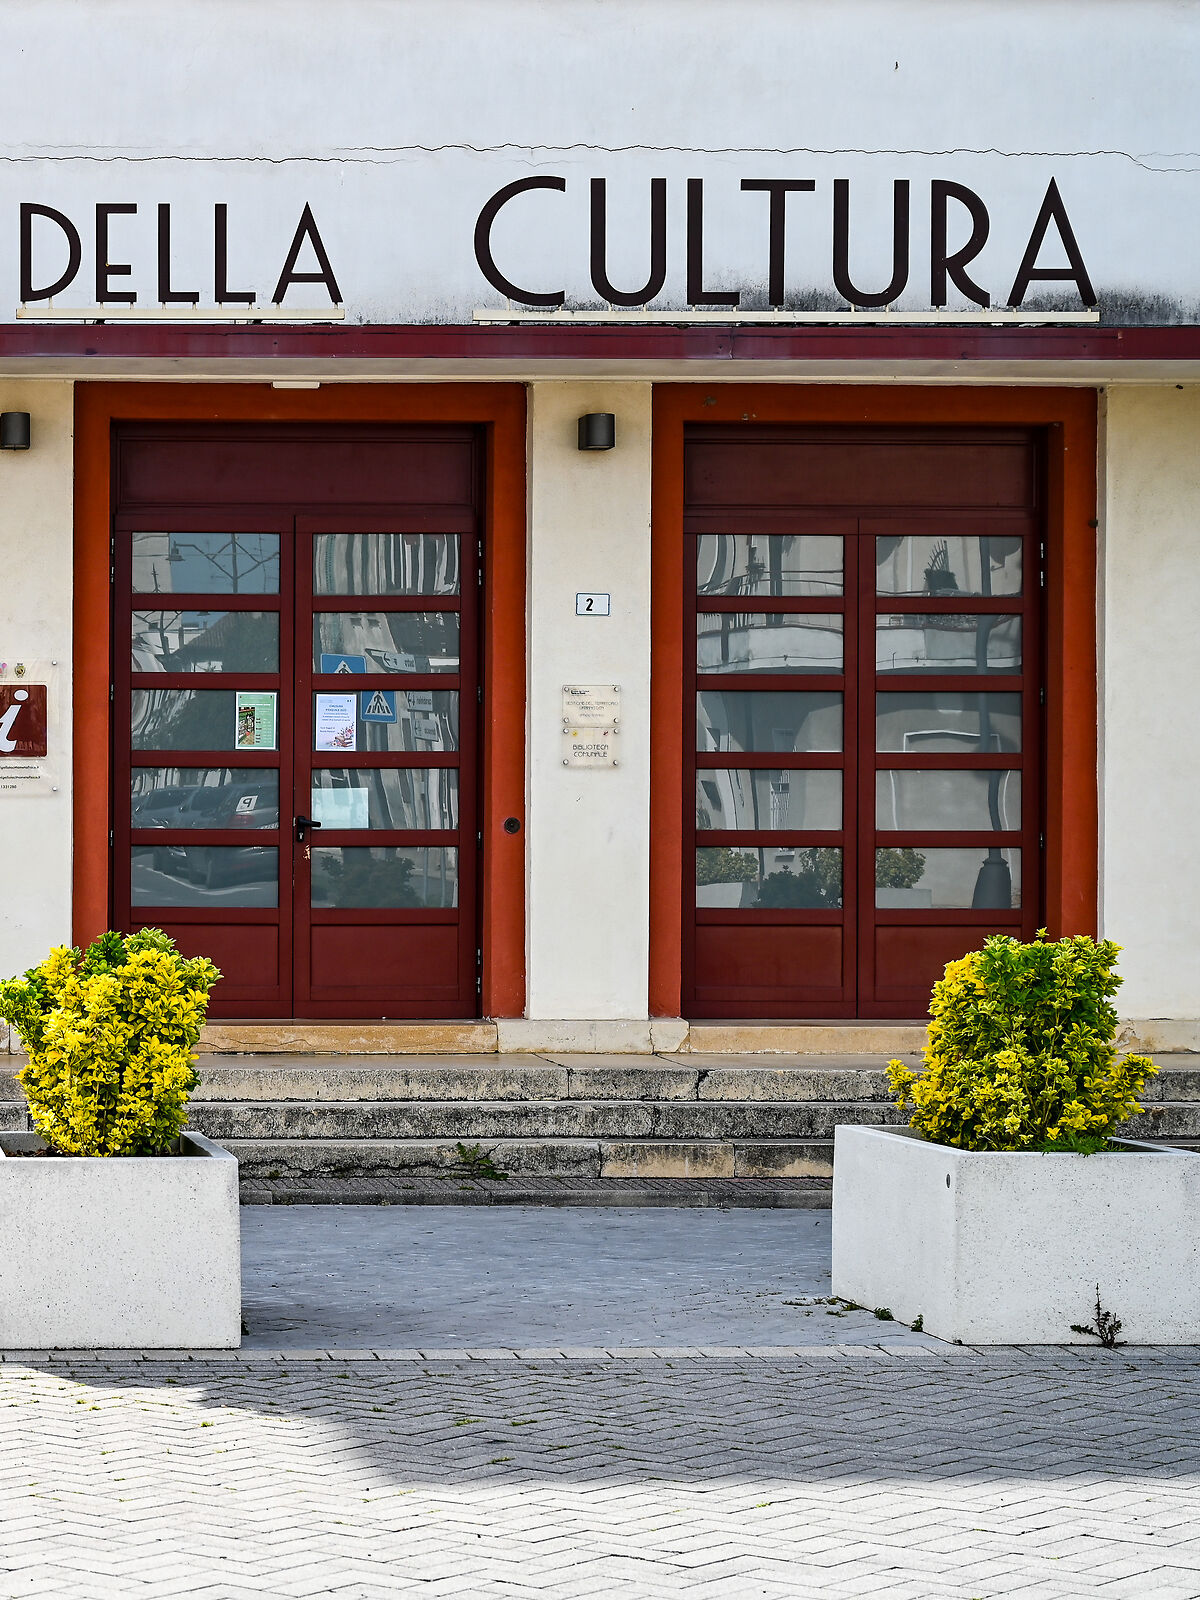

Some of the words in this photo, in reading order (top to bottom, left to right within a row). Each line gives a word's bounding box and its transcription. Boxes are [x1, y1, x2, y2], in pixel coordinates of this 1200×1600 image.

[19, 201, 343, 304] DELLA
[474, 175, 1098, 307] CULTURA
[585, 597, 594, 612] 2
